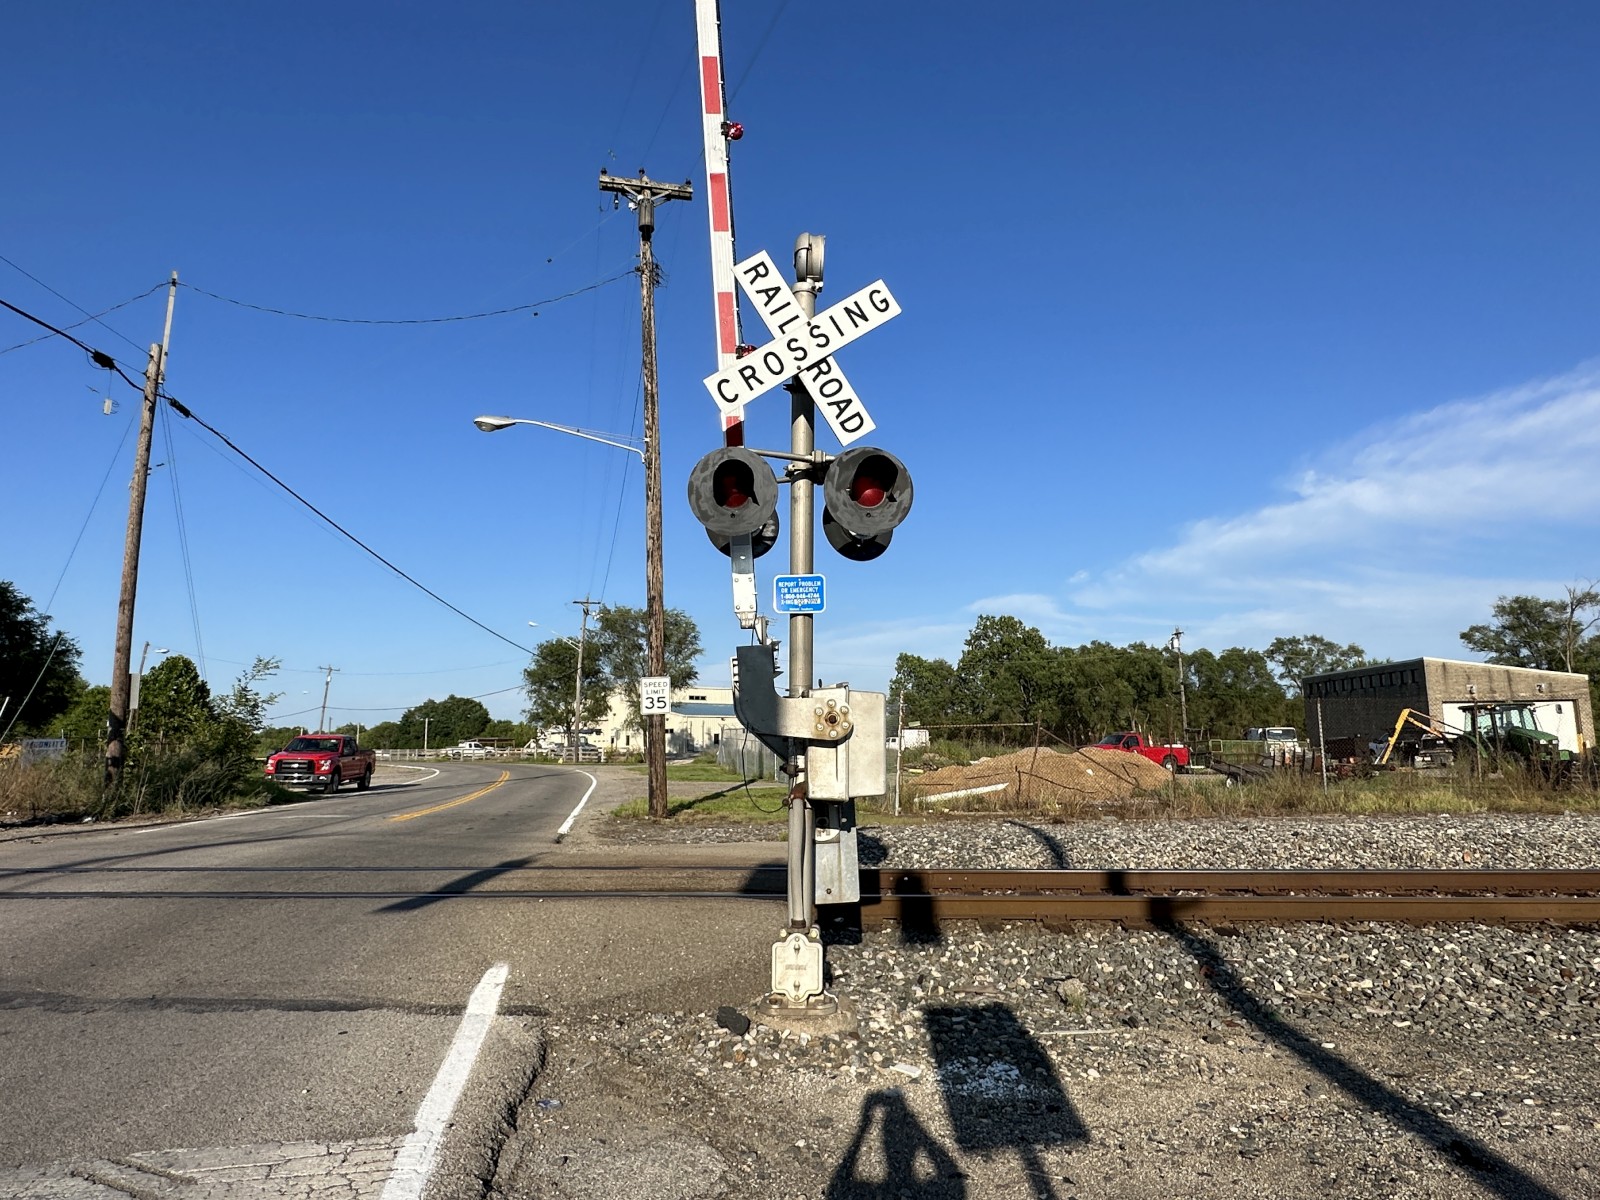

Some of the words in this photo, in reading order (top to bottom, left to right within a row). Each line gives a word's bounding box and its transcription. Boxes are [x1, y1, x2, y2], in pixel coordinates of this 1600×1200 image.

[743, 261, 800, 335] RAIL
[716, 289, 891, 404] CROSSING
[645, 697, 667, 709] 35
